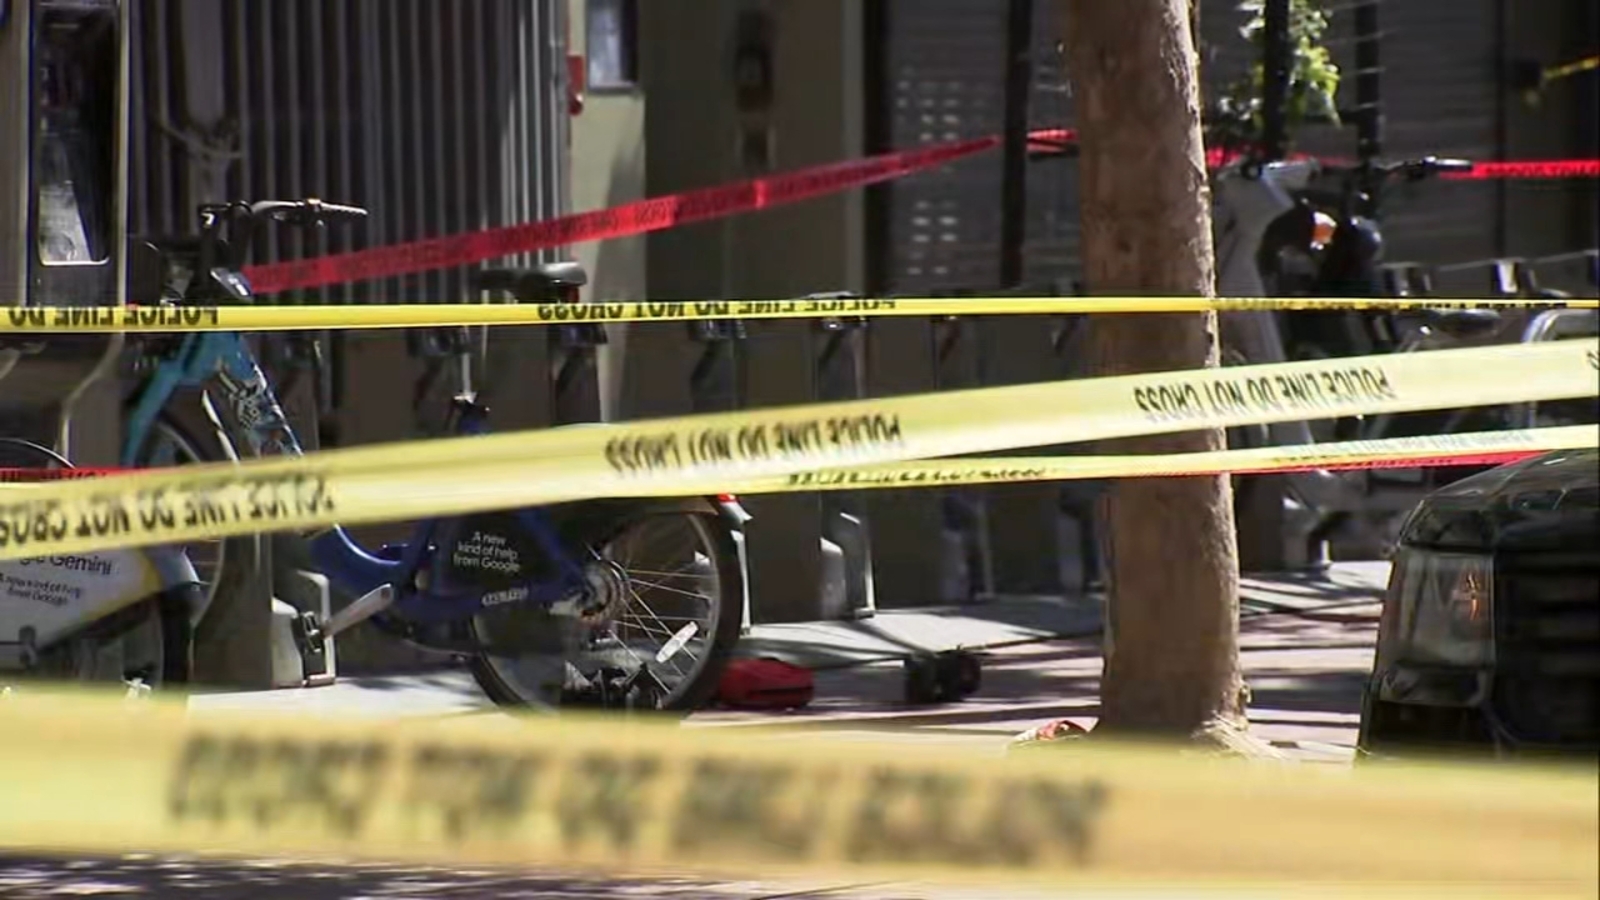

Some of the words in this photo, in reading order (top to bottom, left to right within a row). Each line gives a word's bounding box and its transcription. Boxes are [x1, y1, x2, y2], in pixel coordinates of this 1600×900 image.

[1204, 380, 1249, 417] NOT
[1247, 377, 1287, 415] DO
[1275, 374, 1328, 410] LINE
[1321, 366, 1396, 403] POLICE
[1132, 384, 1208, 423] CROSS
[483, 534, 506, 547] new
[50, 554, 112, 575] Gemini
[453, 552, 480, 567] from
[481, 556, 521, 573] Google
